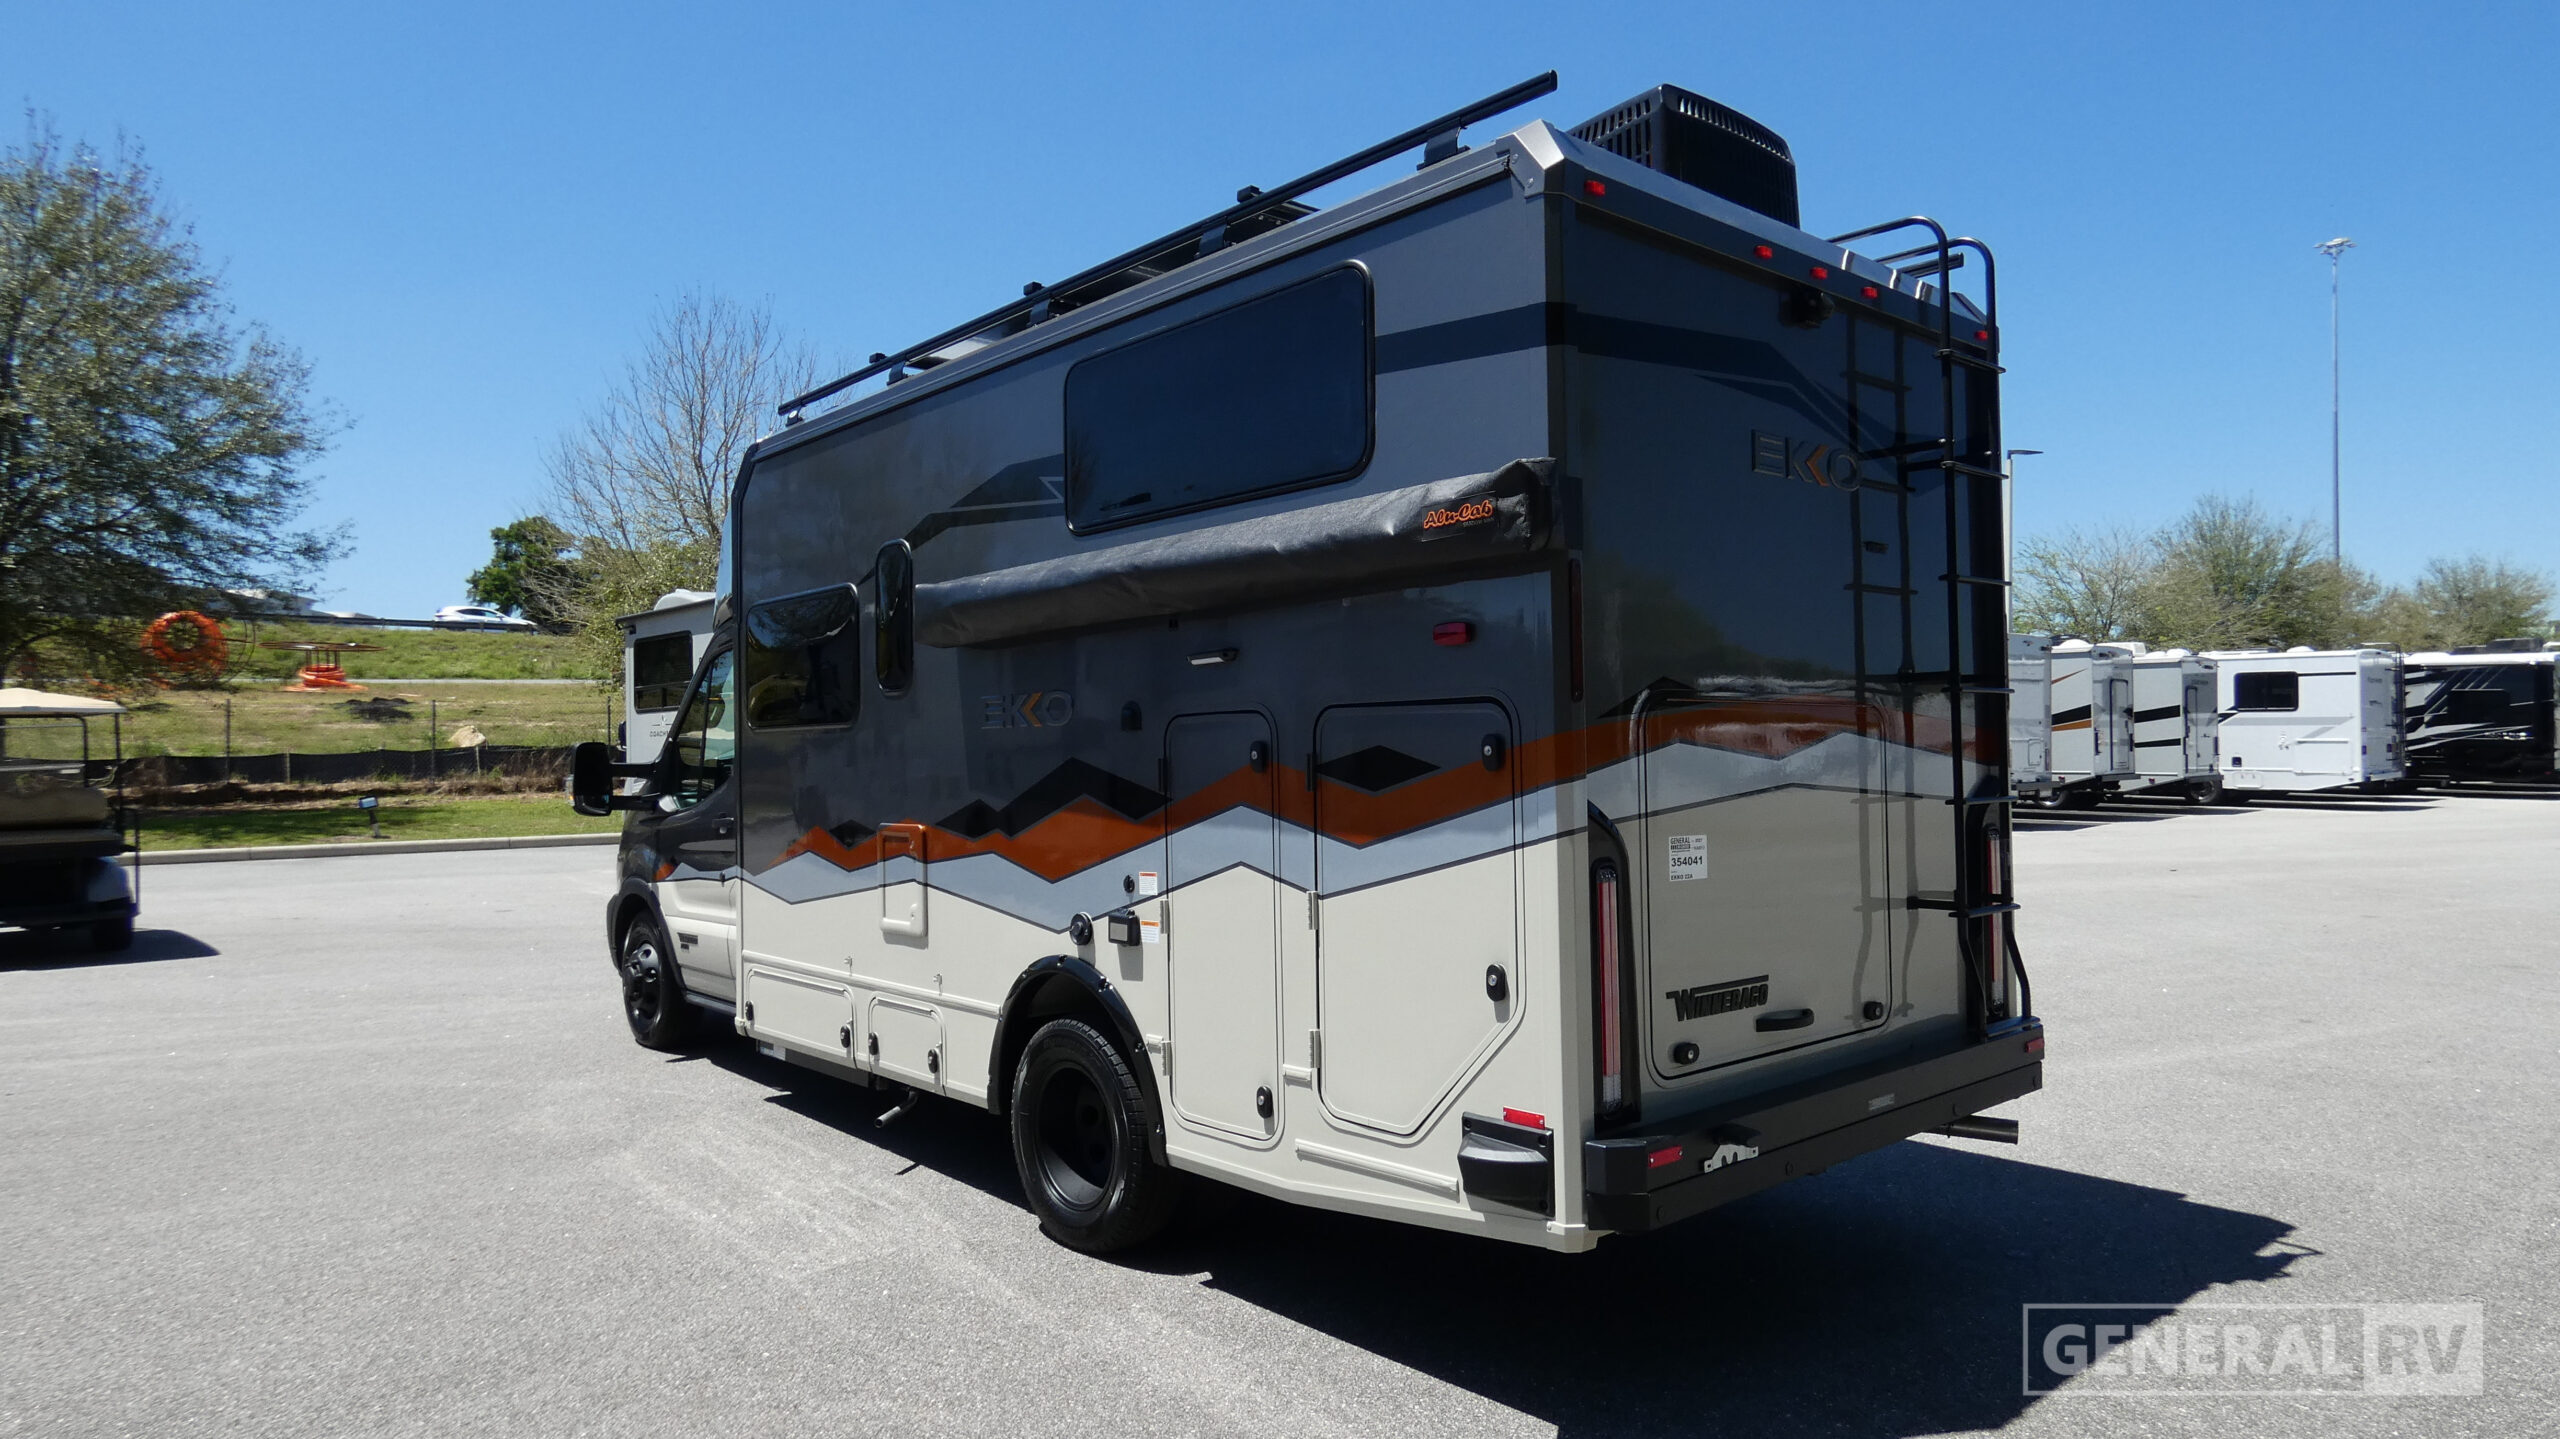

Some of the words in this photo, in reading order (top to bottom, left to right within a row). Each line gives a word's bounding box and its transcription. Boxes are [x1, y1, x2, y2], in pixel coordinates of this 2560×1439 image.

[1750, 428, 1859, 492] EKKO
[1423, 499, 1494, 529] Alu-Cab
[980, 690, 1073, 730] EKKO
[1671, 855, 1703, 867] 354041
[1665, 974, 1769, 1022] WINNEBAGO
